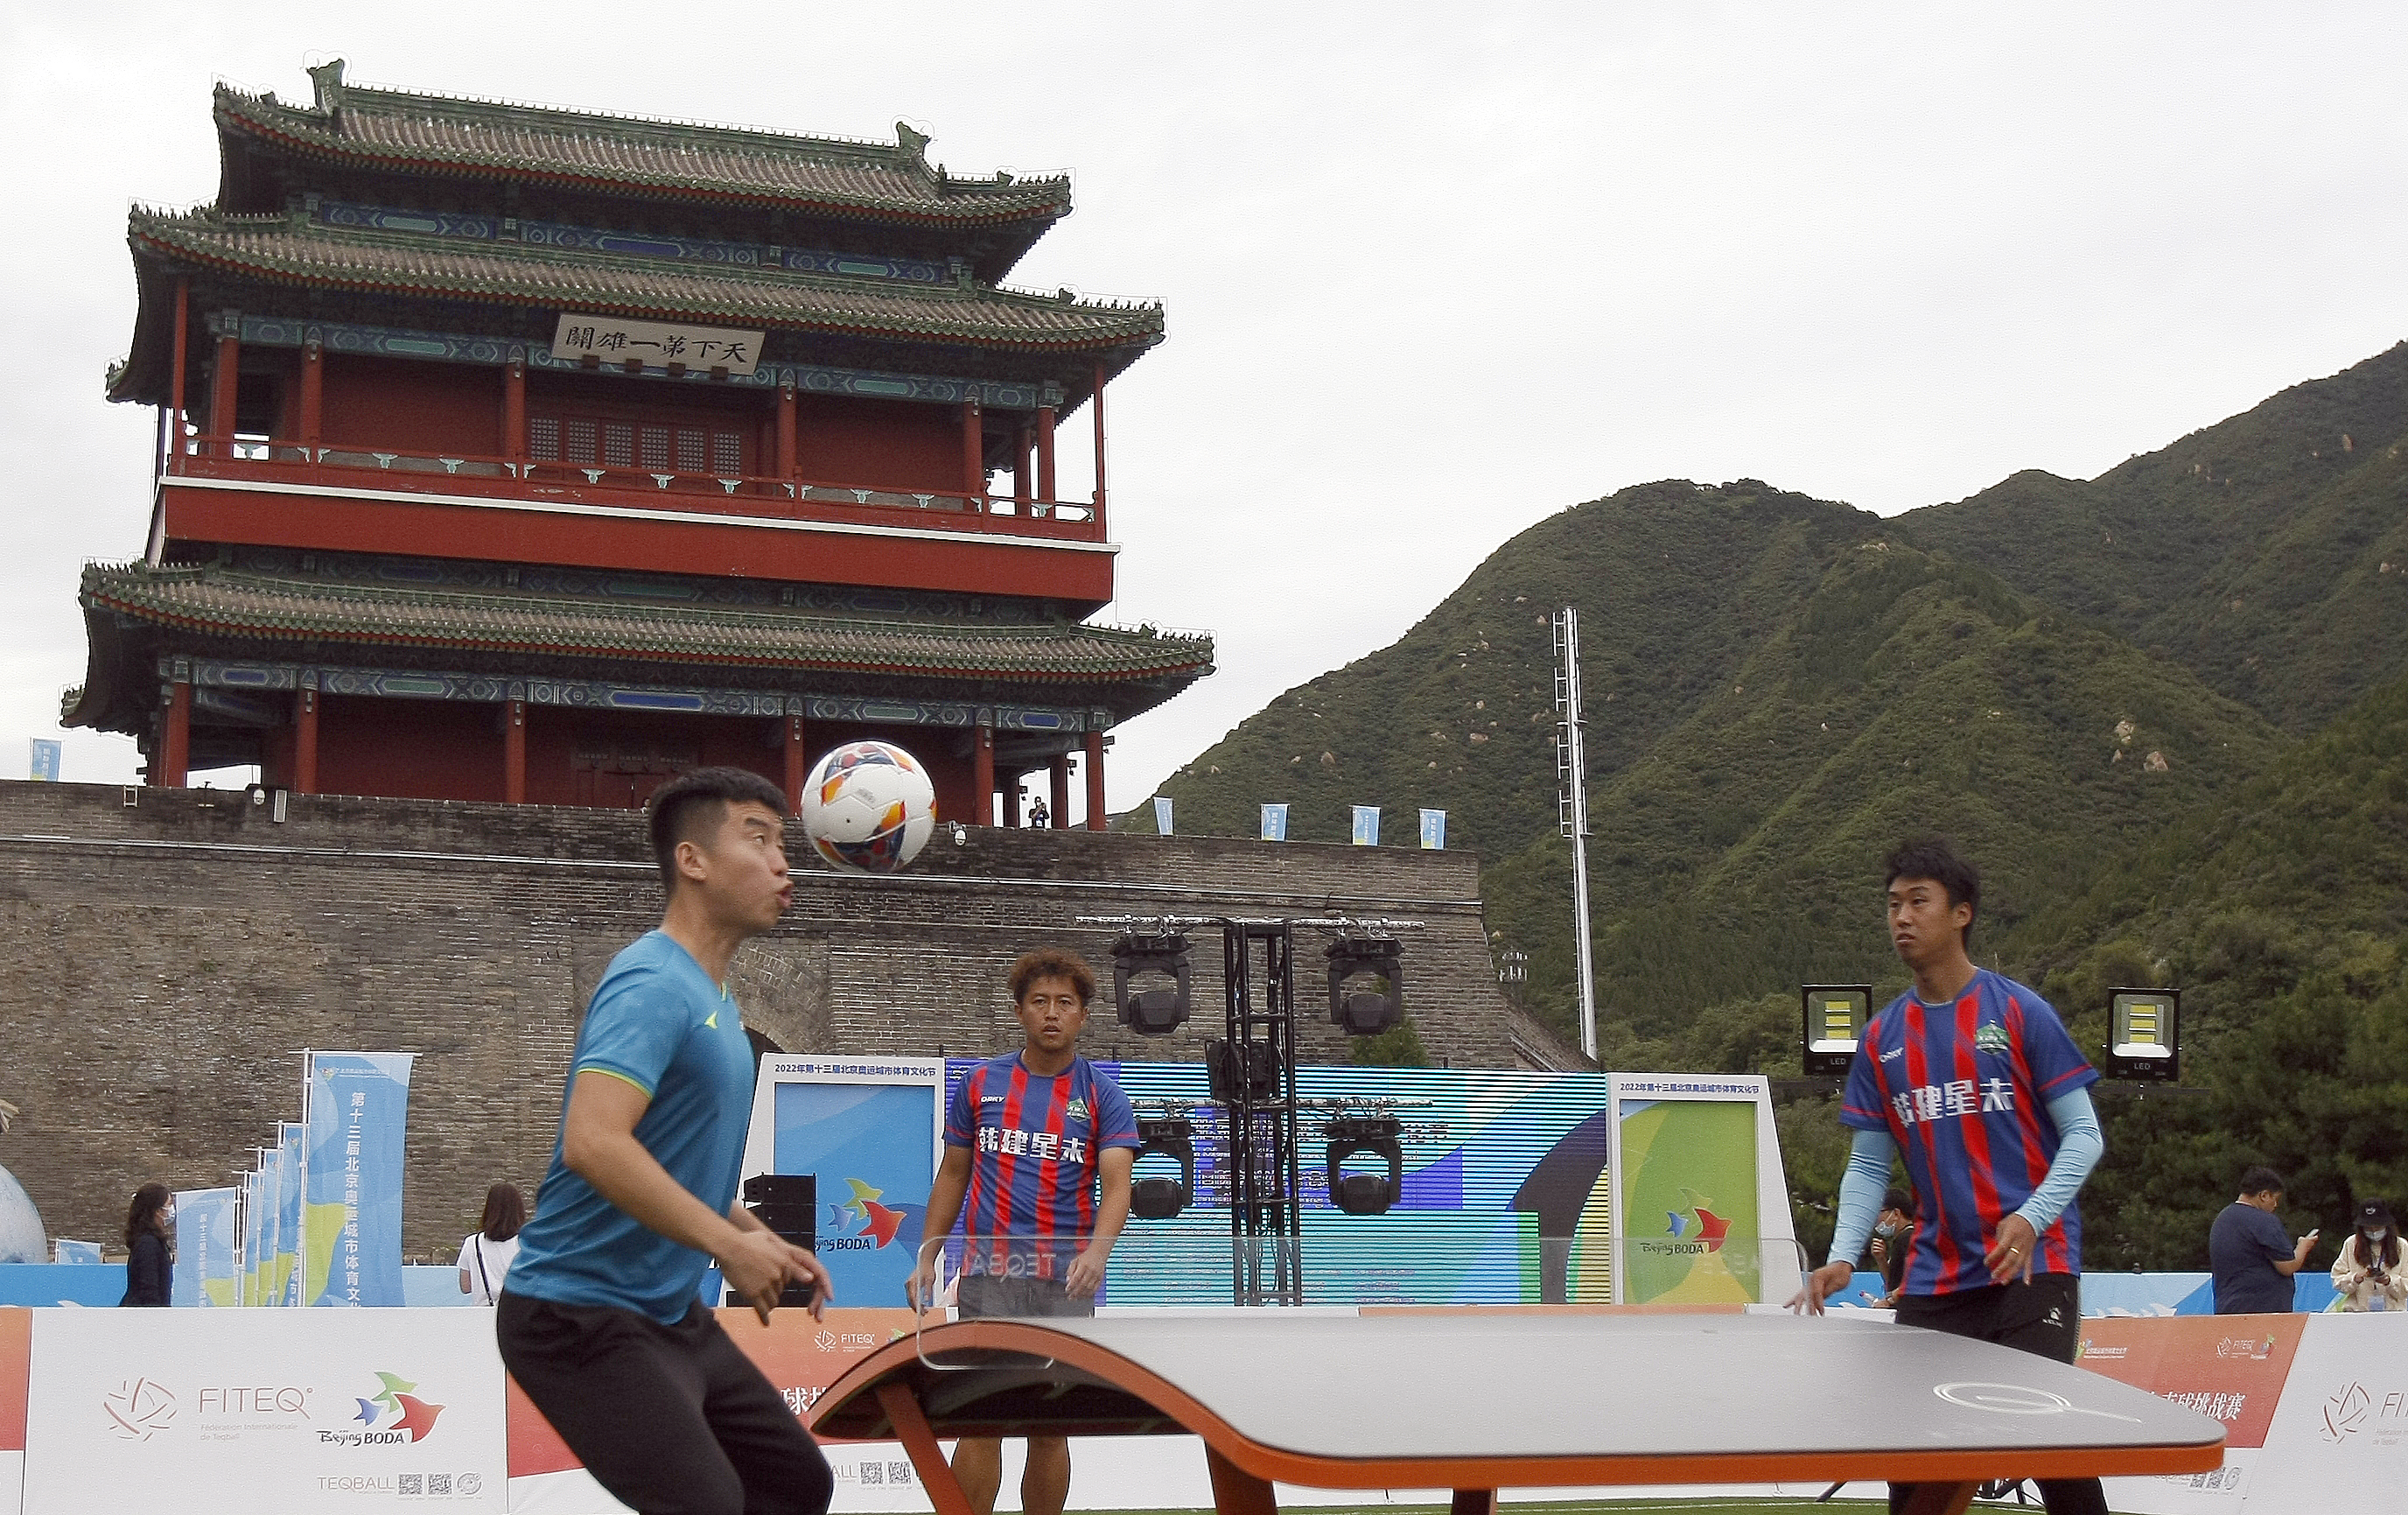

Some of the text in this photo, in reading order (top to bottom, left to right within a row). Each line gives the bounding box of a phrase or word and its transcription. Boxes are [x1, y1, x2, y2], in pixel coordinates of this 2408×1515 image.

[837, 1238, 871, 1250] BODA
[1675, 1244, 1704, 1253] BODA
[2380, 1392, 2408, 1417] FI
[316, 1430, 404, 1447] Beijing BODA
[318, 1476, 395, 1491] TEQBALL
